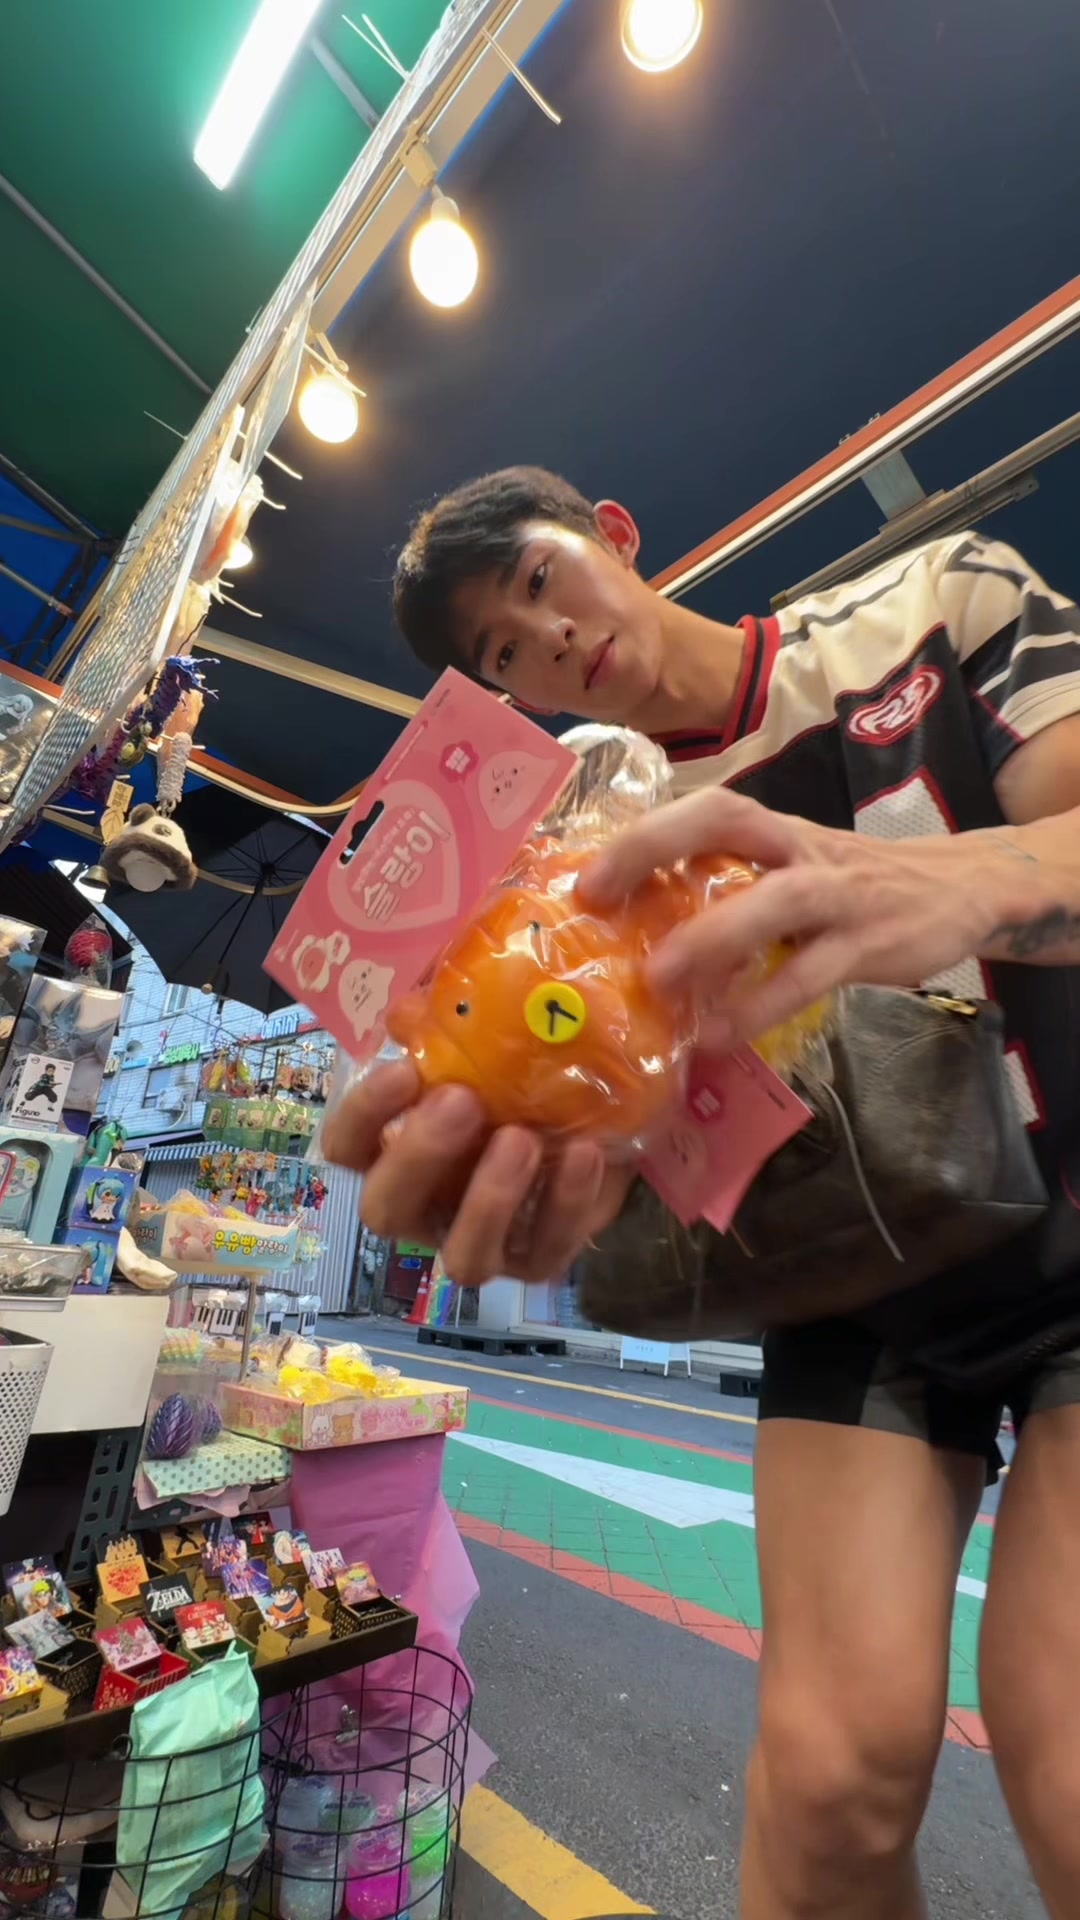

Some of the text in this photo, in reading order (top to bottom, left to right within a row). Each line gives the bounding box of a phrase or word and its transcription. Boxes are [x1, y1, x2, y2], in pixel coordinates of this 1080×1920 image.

[364, 810, 451, 924] 슬랑이
[211, 1230, 258, 1256] 우유빵
[146, 1587, 193, 1612] ZELDA
